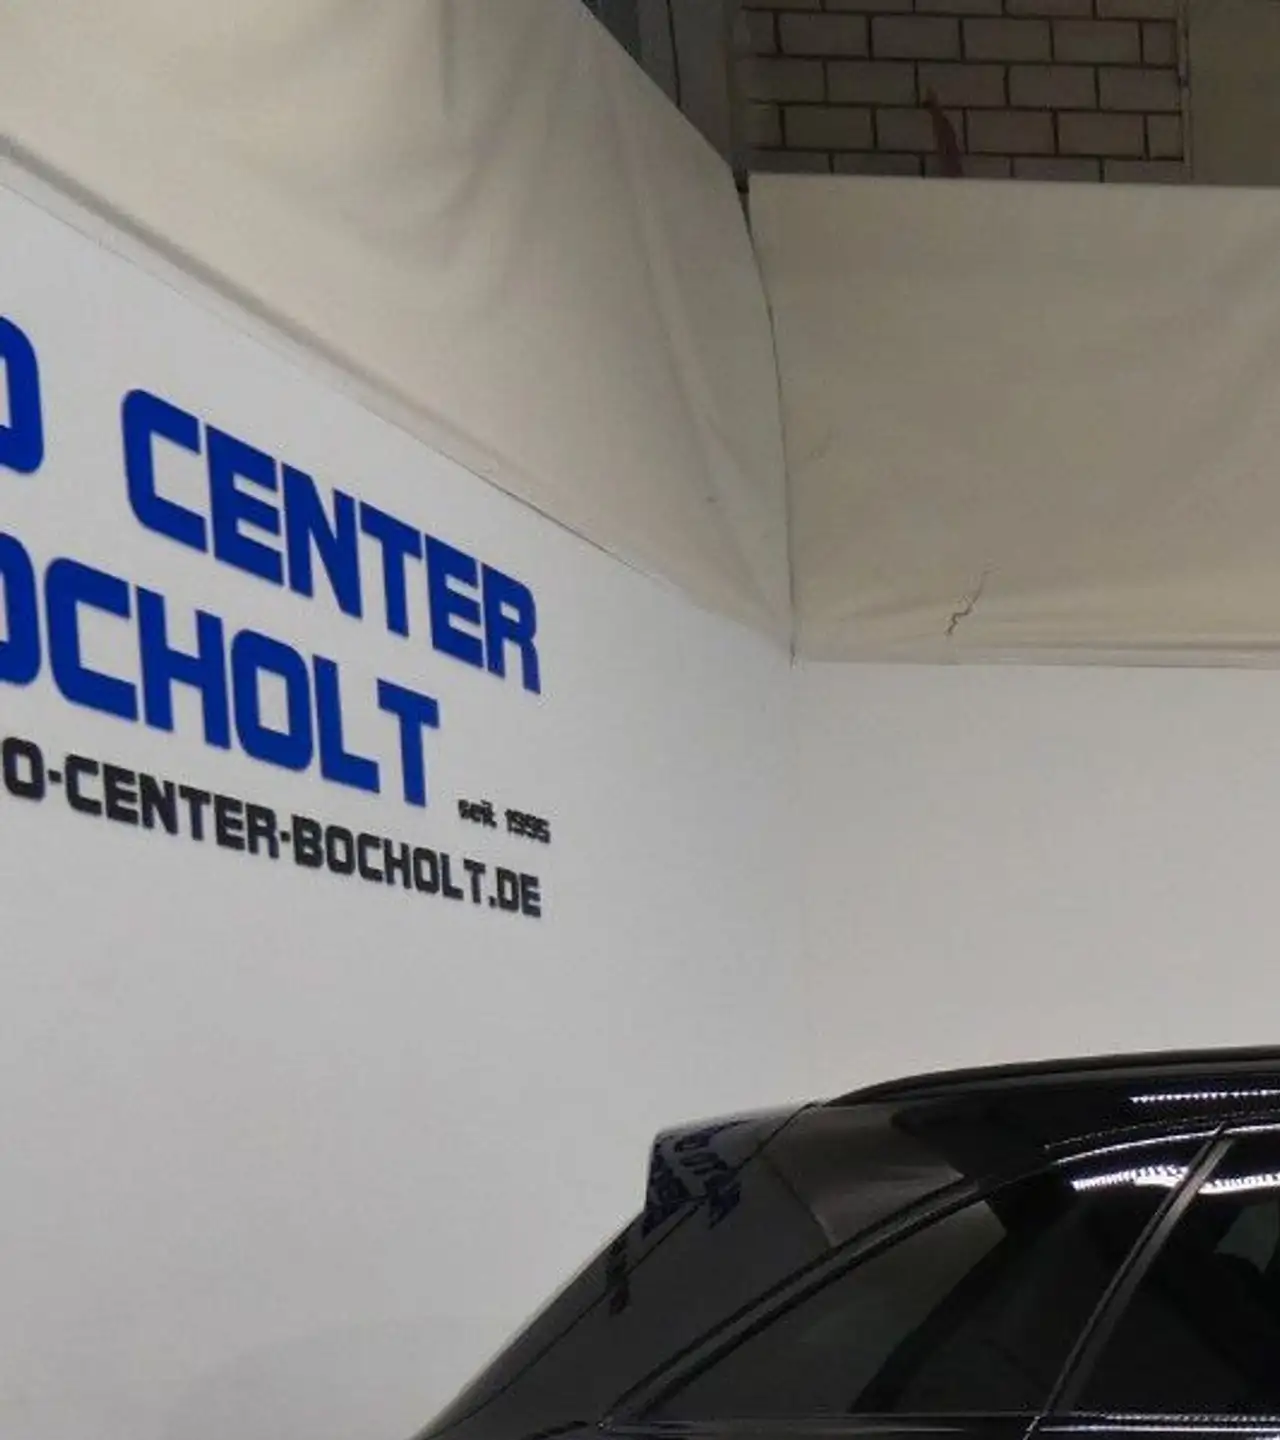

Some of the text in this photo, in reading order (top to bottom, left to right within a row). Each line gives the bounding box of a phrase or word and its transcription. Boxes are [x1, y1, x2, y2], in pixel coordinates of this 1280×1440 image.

[121, 388, 541, 694] CENTER
[1, 736, 542, 919] O-CENTER-BOCHOLT.DE
[458, 799, 498, 829] seit
[504, 808, 551, 844] 1995
